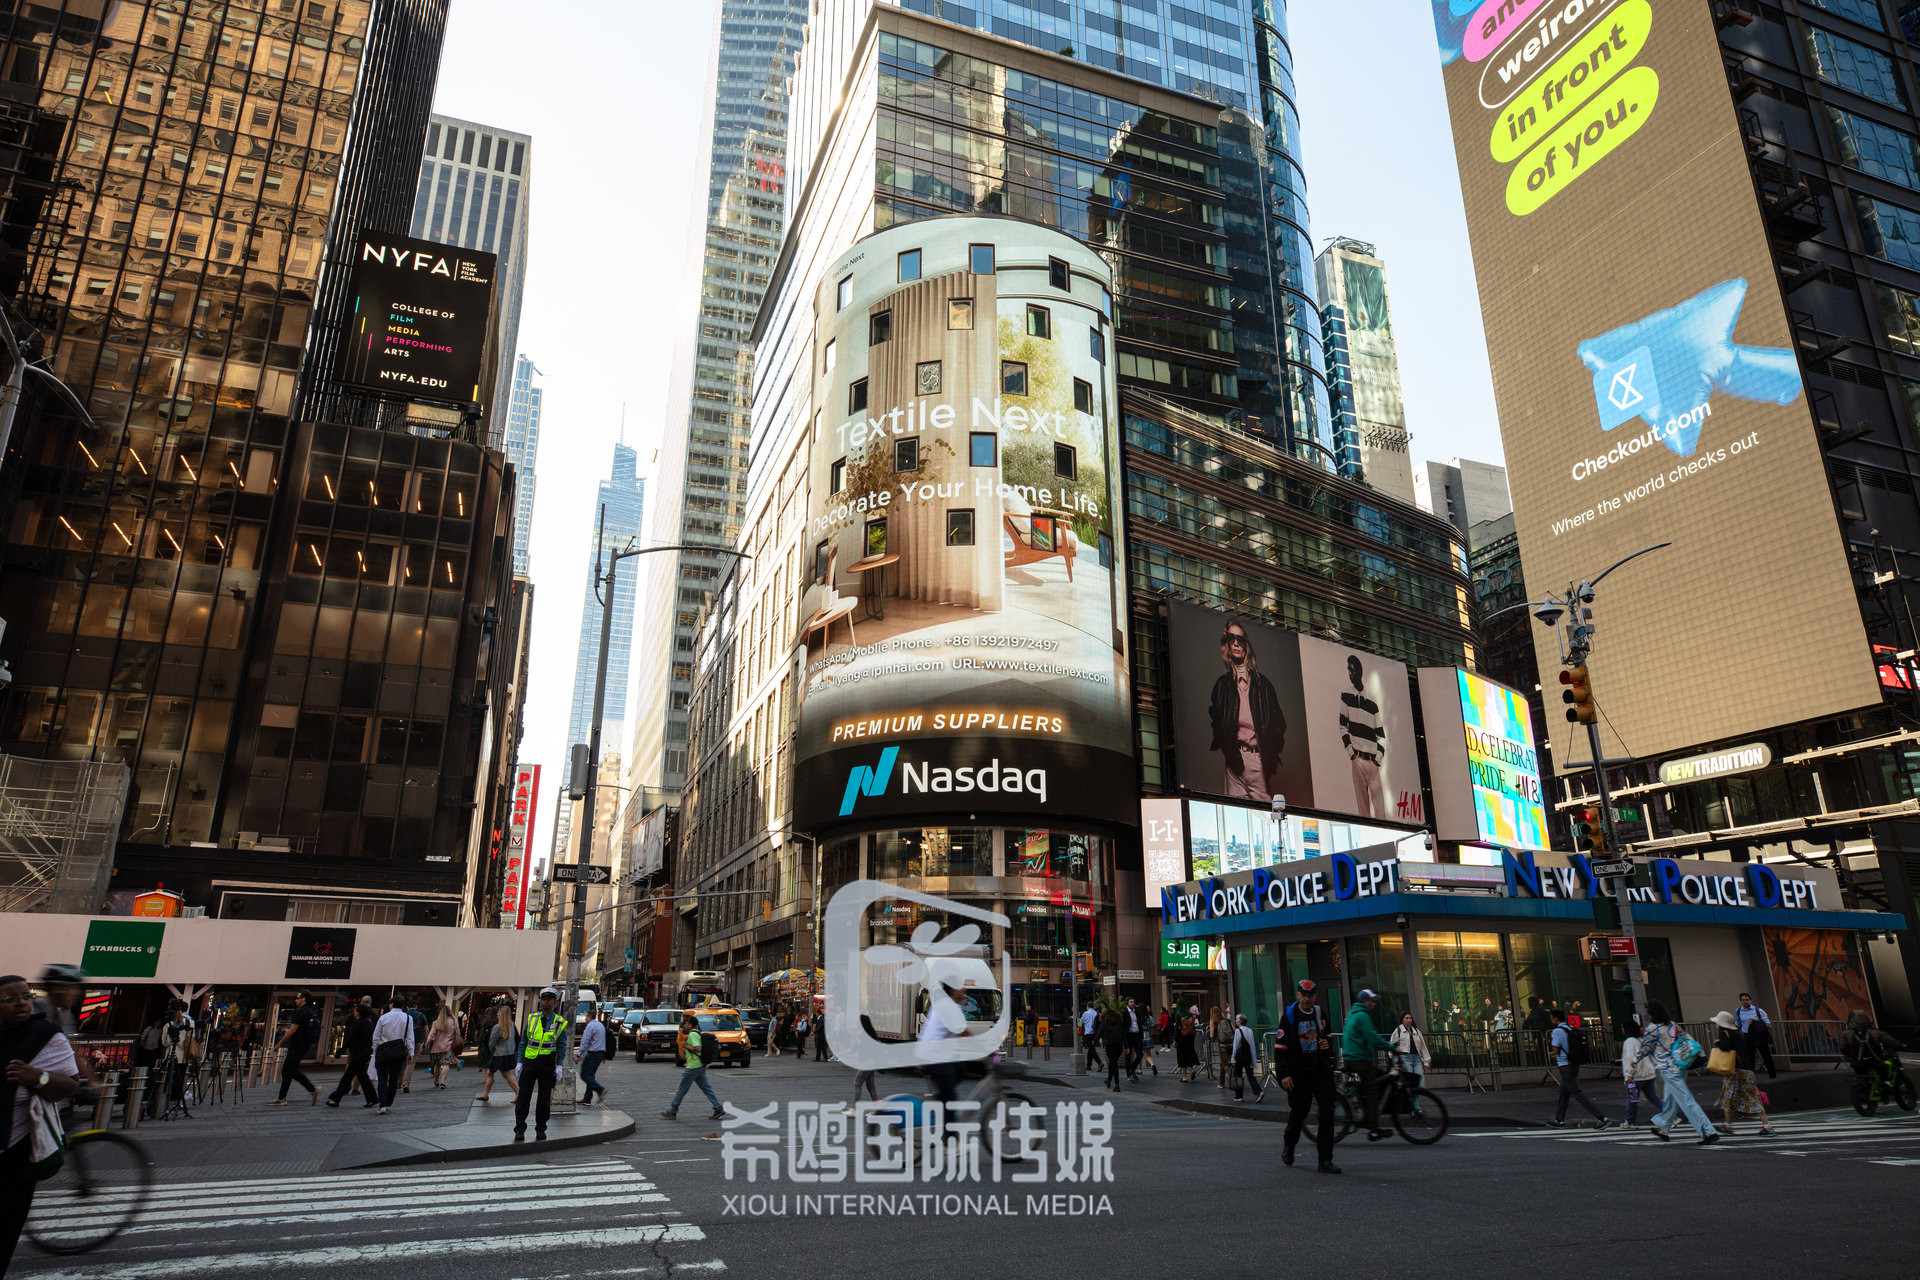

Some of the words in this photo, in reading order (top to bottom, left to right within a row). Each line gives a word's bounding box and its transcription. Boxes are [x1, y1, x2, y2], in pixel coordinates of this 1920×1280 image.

[1482, 0, 1528, 39] an
[1507, 107, 1537, 142] in
[1542, 22, 1629, 112] front
[1526, 148, 1558, 192] of
[1564, 95, 1639, 168] you.
[362, 242, 450, 276] NYFA
[460, 275, 488, 284] ACADEMY
[390, 314, 414, 324] FILM
[391, 302, 438, 317] COLLEGE
[441, 311, 455, 320] OF
[386, 335, 453, 353] PERFORMING
[388, 325, 420, 337] MEDIA
[384, 347, 410, 357] ARTS
[380, 370, 448, 388] NYFA.EDU
[836, 400, 956, 453] Textile
[973, 397, 1067, 439] Next
[1571, 401, 1712, 482] Checkout.com
[1551, 507, 1595, 536] Where
[1597, 494, 1622, 516] the
[1623, 474, 1665, 504] world
[1668, 447, 1727, 483] checks
[1730, 430, 1760, 454] out
[812, 490, 891, 537] Decorate
[900, 481, 965, 502] Your
[975, 477, 1052, 504] Home
[1061, 488, 1103, 520] Life.
[892, 637, 933, 651] Phone
[944, 636, 970, 646] +86
[974, 635, 1059, 651] 13921972497
[833, 715, 924, 742] PREMIUM
[933, 713, 1063, 733] SUPPLIERS
[902, 758, 1047, 803] Nasdaq
[1470, 760, 1508, 794] PRIDE
[513, 772, 530, 825] PARK
[1397, 791, 1422, 822] H&M
[503, 857, 521, 912] PARK
[1161, 885, 1199, 924] NEW
[1199, 878, 1251, 919] YORK
[1253, 868, 1326, 911] POLICE
[1331, 853, 1401, 900] DEPT
[1502, 848, 1576, 898] NEW
[1653, 858, 1749, 906] POLICE
[1748, 864, 1817, 909] DEPT
[1026, 906, 1047, 914] Nasdaq
